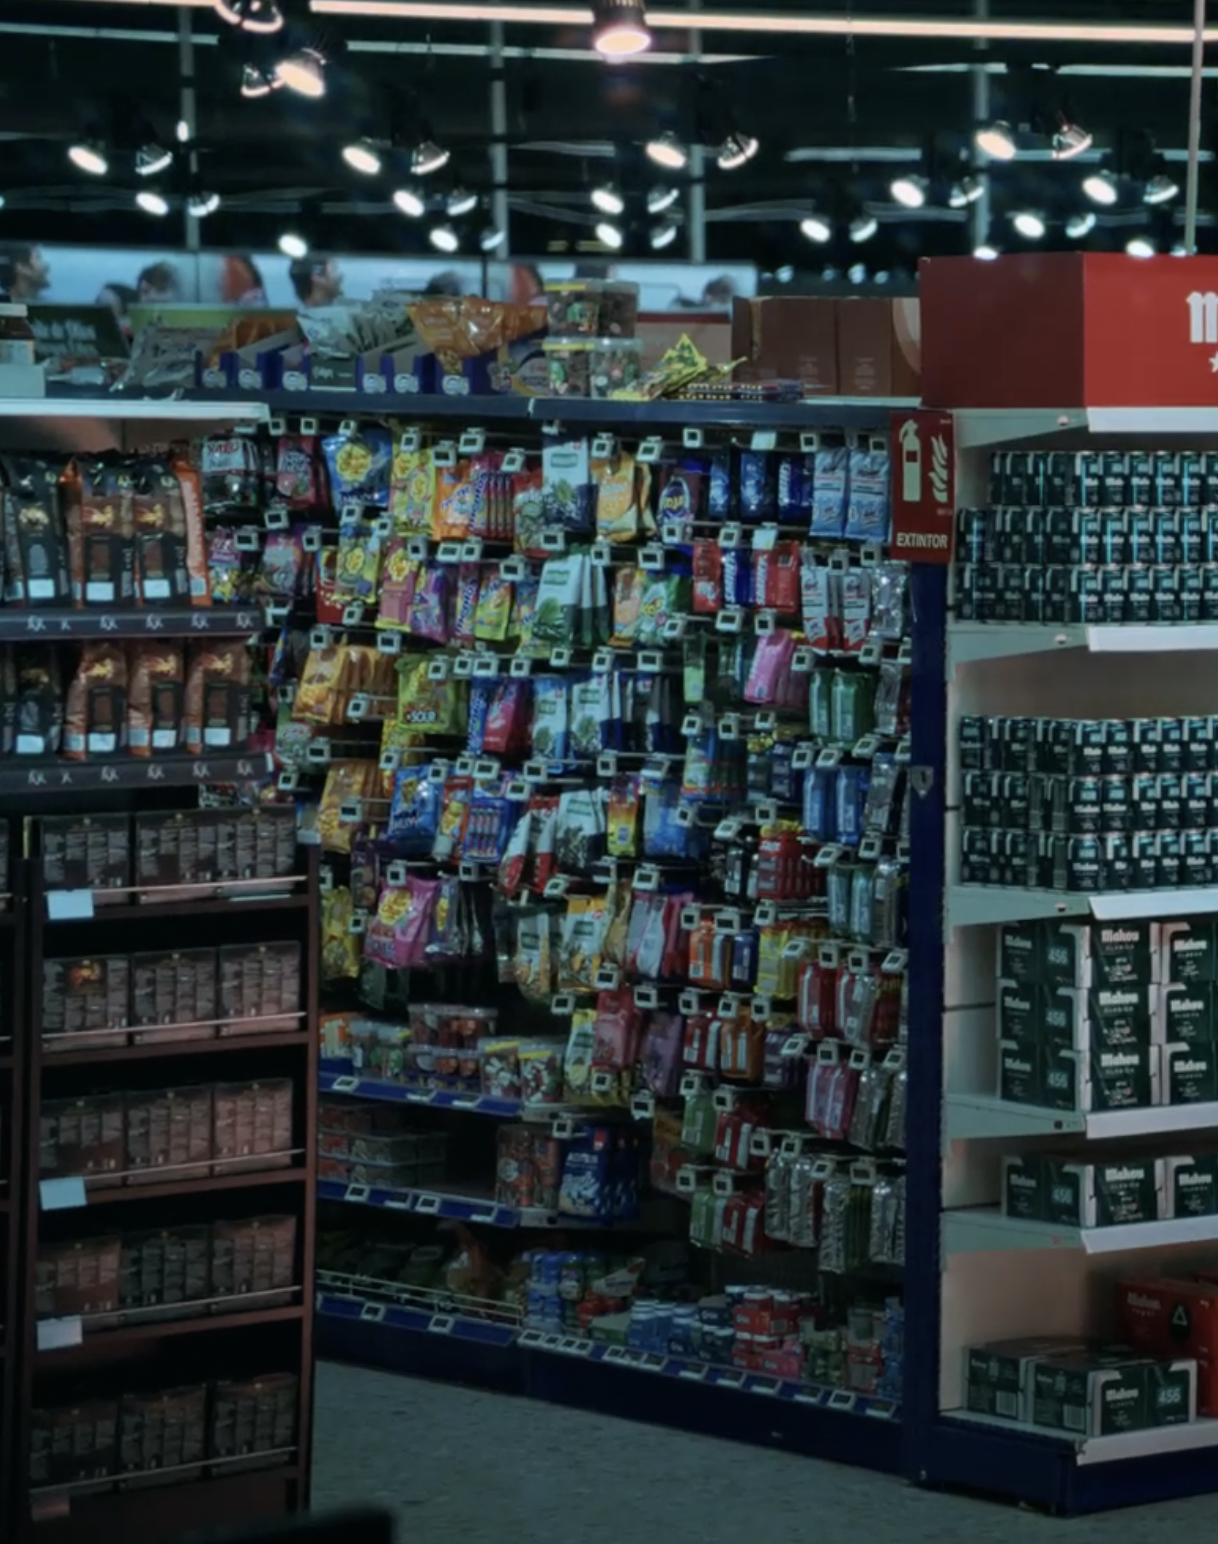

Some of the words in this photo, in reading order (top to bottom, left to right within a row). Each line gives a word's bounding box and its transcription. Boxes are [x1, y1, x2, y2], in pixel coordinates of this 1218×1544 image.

[896, 532, 948, 548] EXTINTOR
[1101, 929, 1140, 943] Mahou
[1101, 1053, 1140, 1067] Mahou
